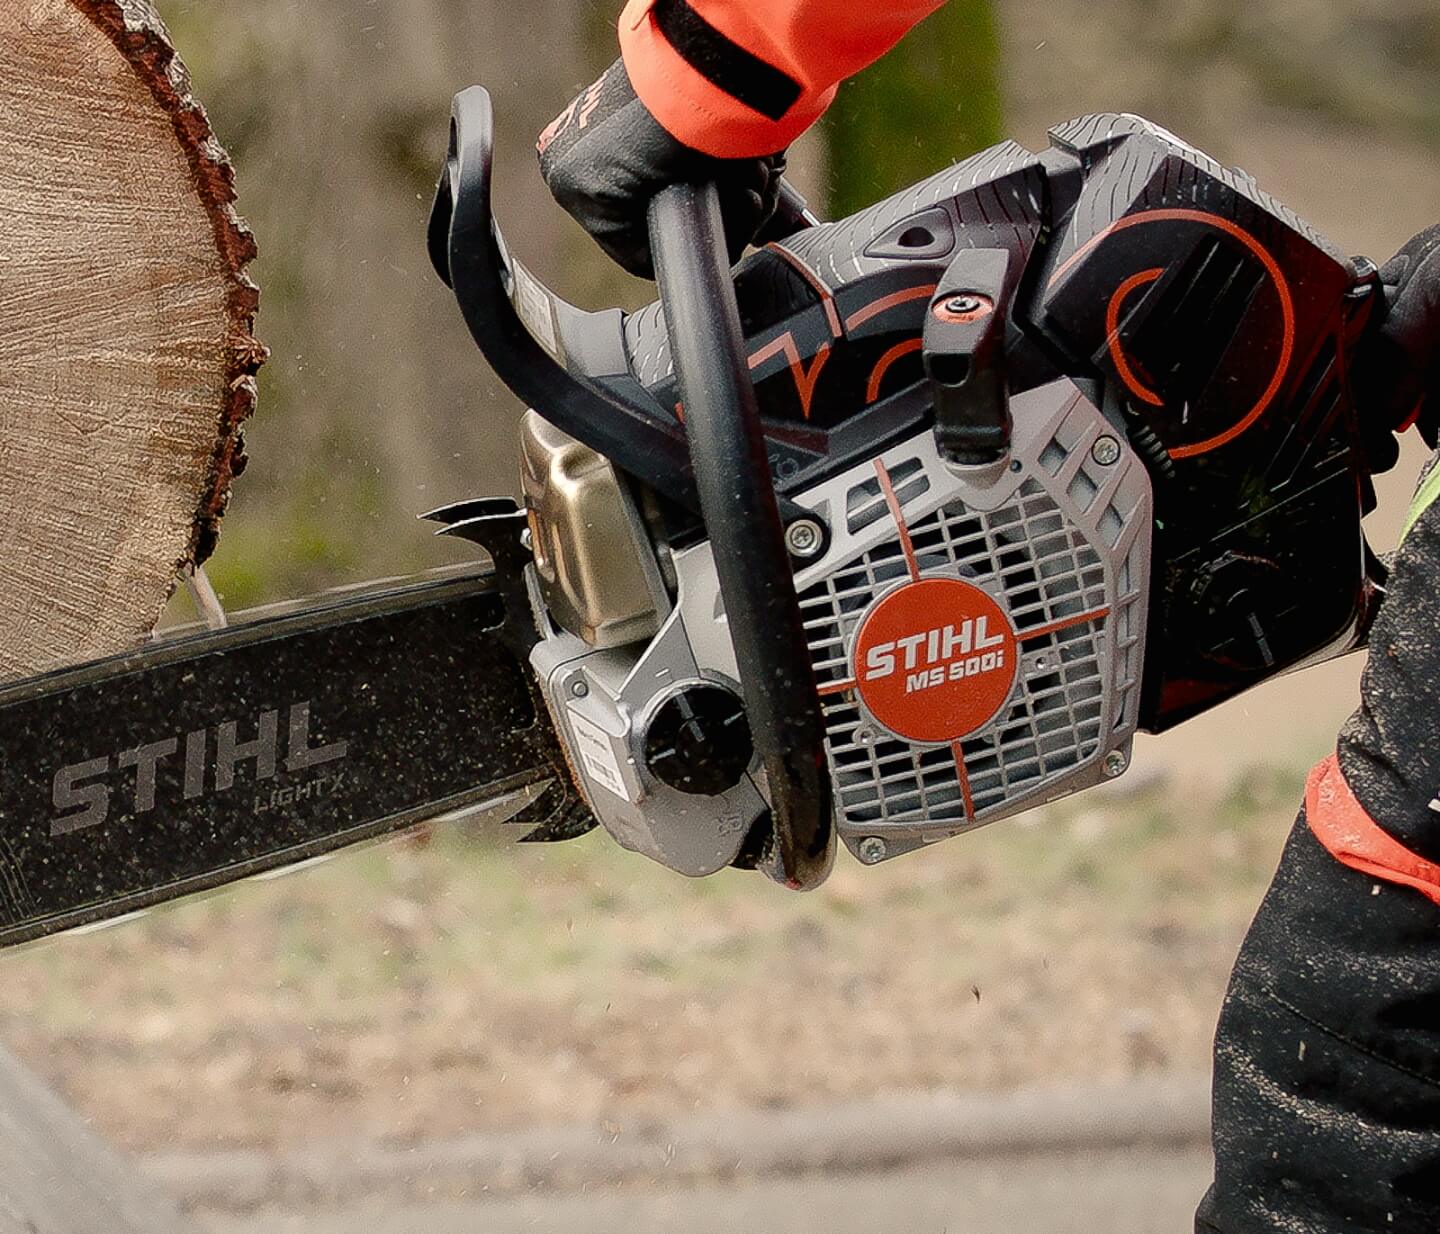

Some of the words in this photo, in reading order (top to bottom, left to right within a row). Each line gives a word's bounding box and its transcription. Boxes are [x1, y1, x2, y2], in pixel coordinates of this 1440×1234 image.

[865, 615, 1004, 681] STIHL
[906, 666, 945, 693] MS
[948, 650, 1004, 681] 500i
[50, 701, 348, 836] STIHL
